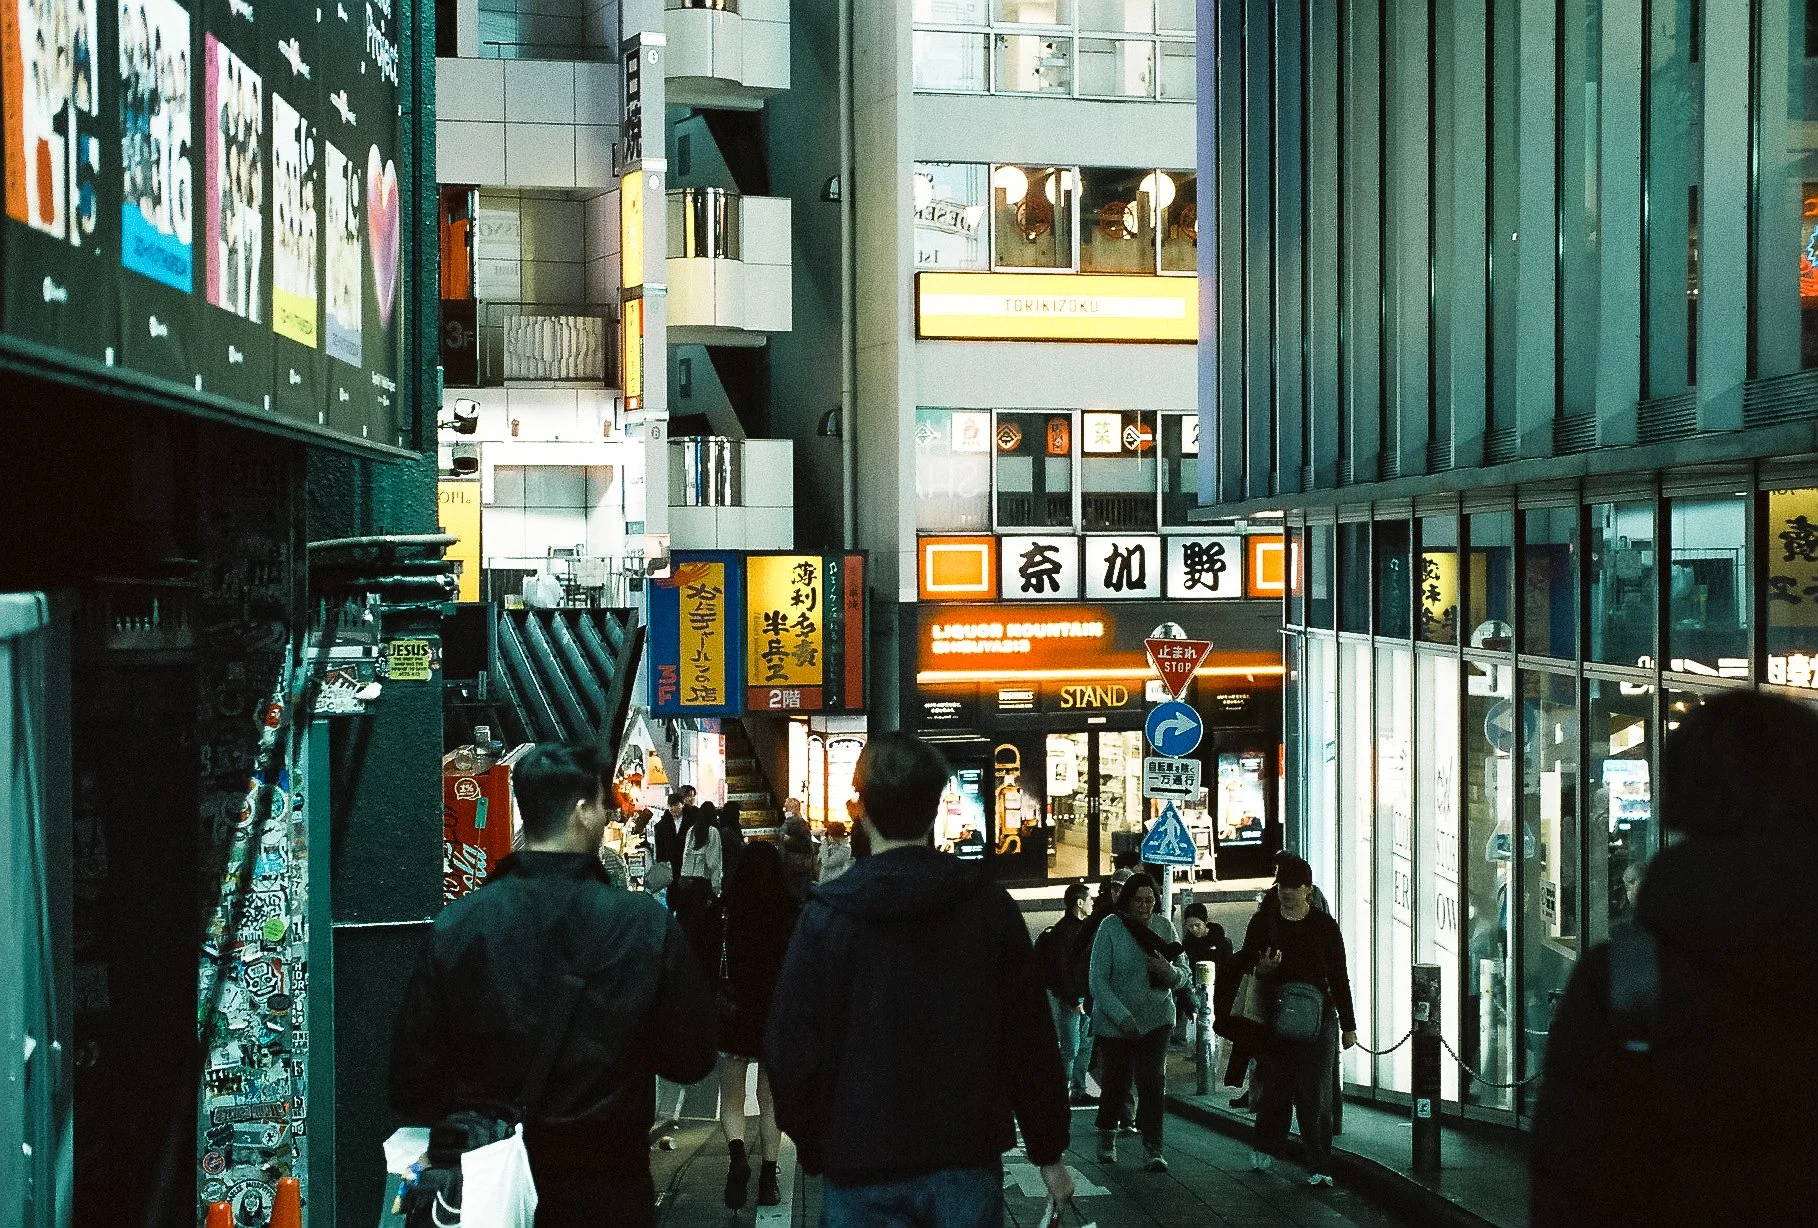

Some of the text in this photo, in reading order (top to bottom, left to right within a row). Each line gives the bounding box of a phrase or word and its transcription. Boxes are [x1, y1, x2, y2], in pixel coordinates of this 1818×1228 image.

[1004, 298, 1099, 313] TORIKIZOKU
[1018, 541, 1226, 594] 奈加野
[932, 622, 1103, 639] LIQUOR MOUNTAIN
[389, 644, 429, 656] JESUS
[1157, 645, 1197, 660] 止まれ
[1163, 661, 1192, 674] STOP
[769, 689, 802, 709] 2階
[1060, 685, 1129, 708] STAND
[1148, 774, 1196, 787] 一方通行
